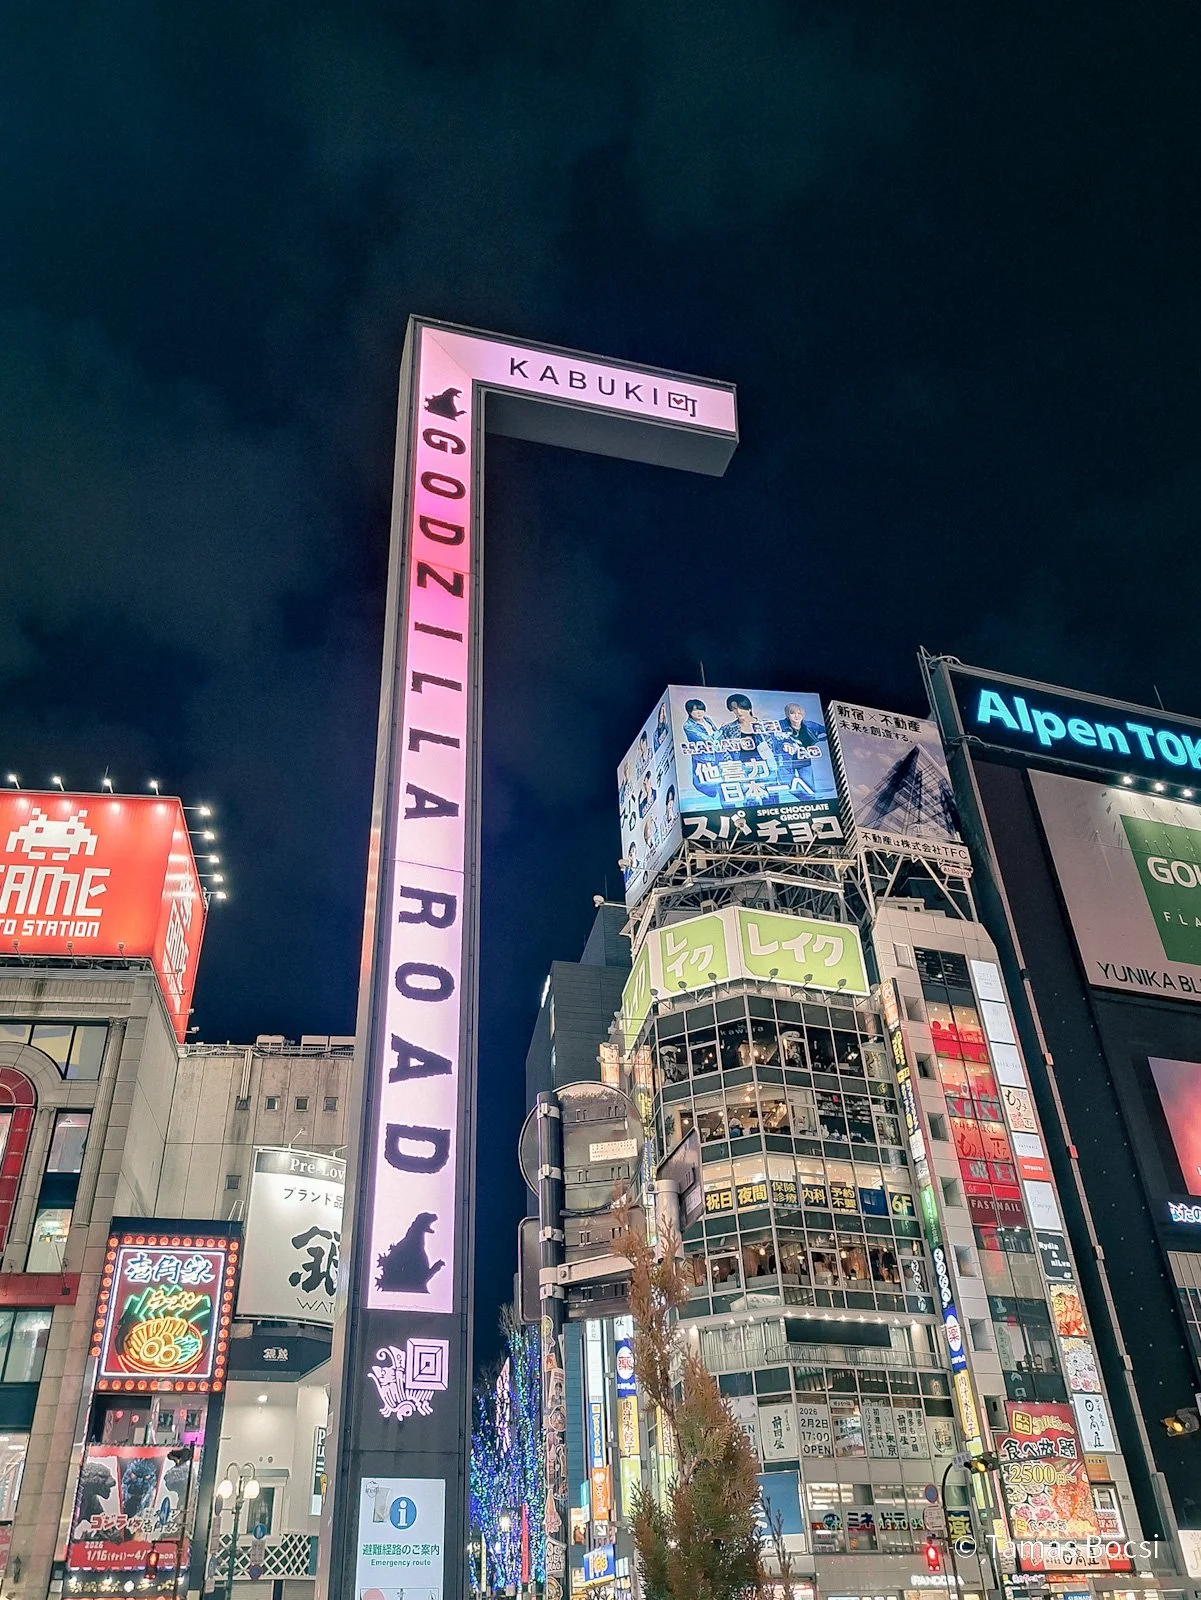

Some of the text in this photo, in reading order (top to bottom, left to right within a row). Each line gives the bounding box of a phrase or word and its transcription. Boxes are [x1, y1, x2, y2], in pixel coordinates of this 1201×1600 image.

[404, 428, 466, 820] GODZILLA
[757, 803, 829, 817] SPICE CHOCOLATE
[780, 812, 812, 822] GROUP
[0, 865, 110, 916] AME
[22, 919, 100, 938] STATION
[748, 922, 844, 967] レイク
[1097, 961, 1177, 991] YUNIKA
[385, 884, 458, 1175] ROAD
[706, 1191, 734, 1212] 祝日
[738, 1185, 767, 1205] 夜間
[802, 1189, 826, 1204] 内科
[892, 1195, 912, 1215] 6F
[970, 1199, 1021, 1212] FASTNAIL
[799, 1407, 818, 1416] 2026
[800, 1418, 829, 1429] 2月2日
[801, 1431, 830, 1442] 17:00
[803, 1444, 831, 1455] OPEN
[84, 1541, 104, 1549] 2026
[362, 1544, 440, 1556] 避難経路のご案内
[370, 1559, 411, 1567] Emergency
